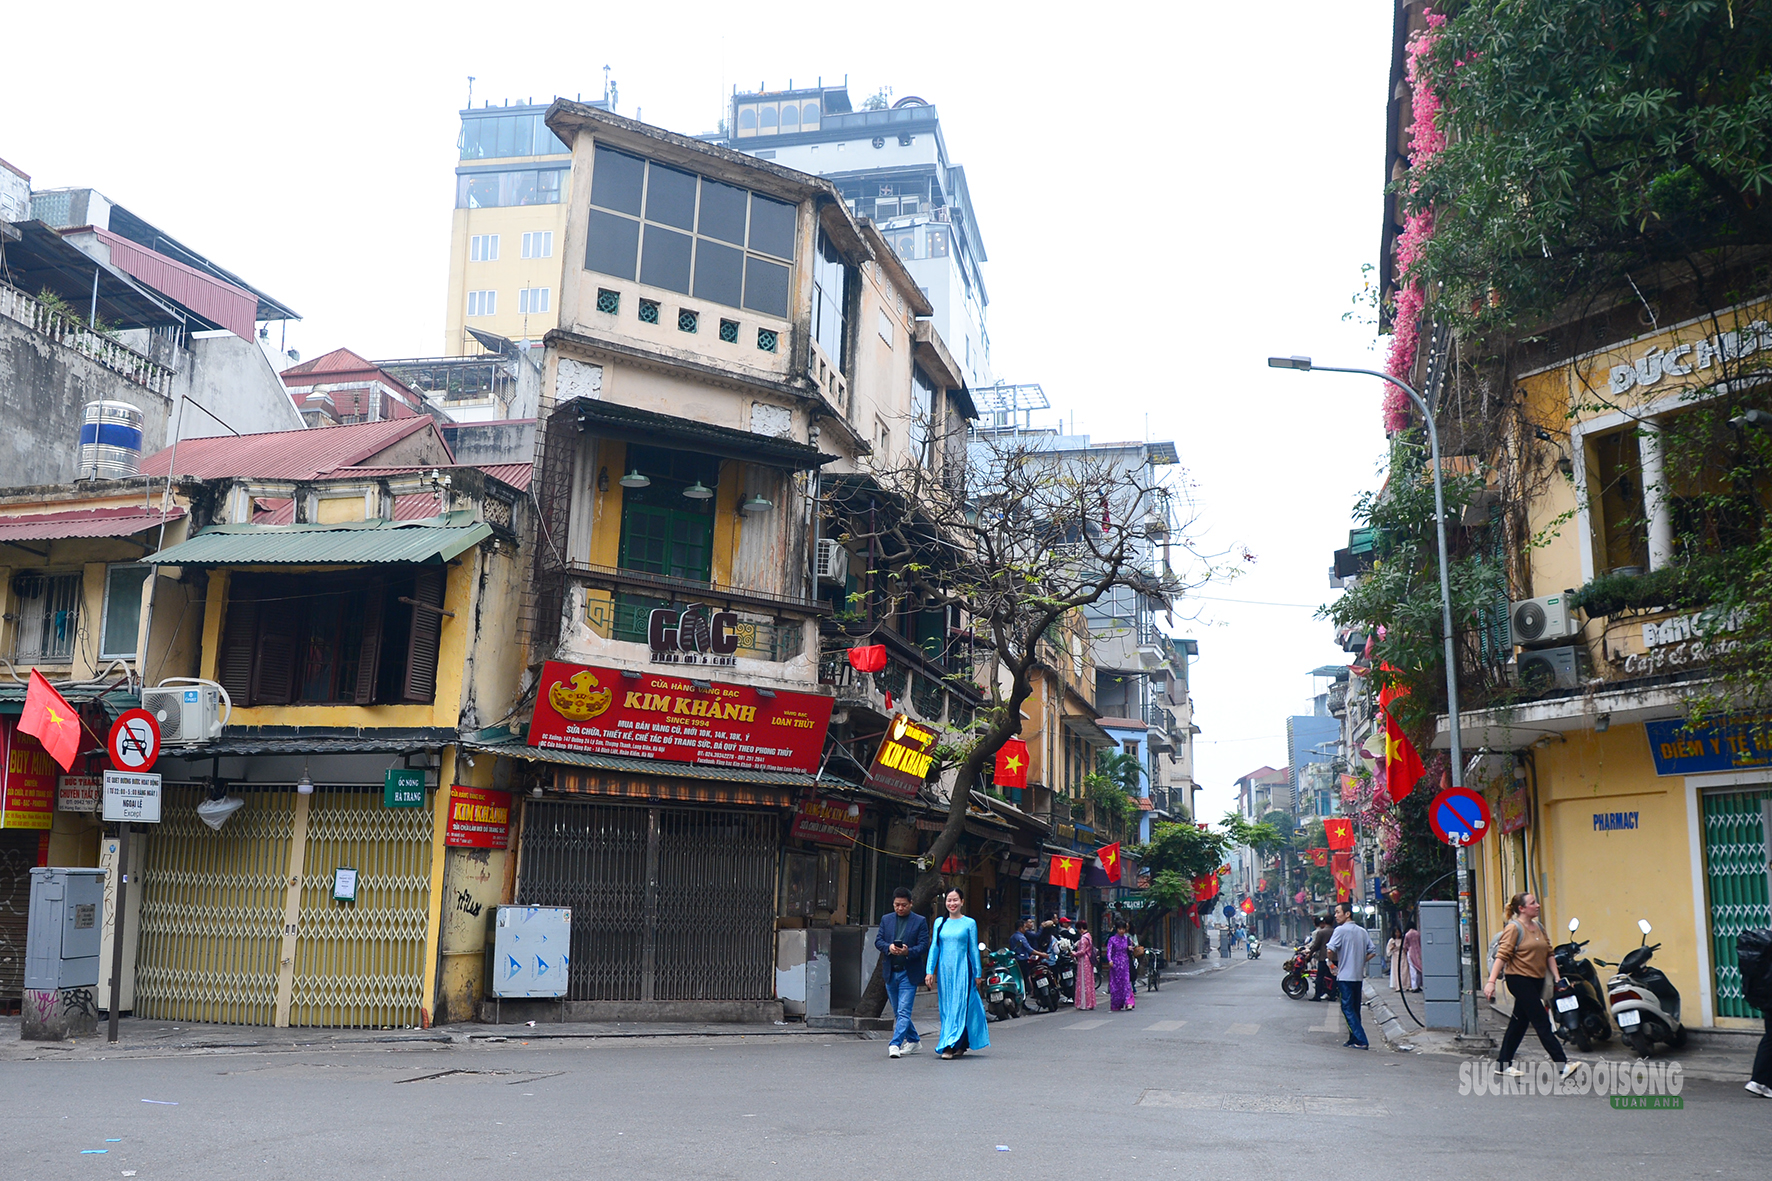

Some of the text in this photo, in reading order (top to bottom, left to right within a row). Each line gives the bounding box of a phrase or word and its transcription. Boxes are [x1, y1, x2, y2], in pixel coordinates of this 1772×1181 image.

[1625, 647, 1666, 675] Café
[651, 679, 668, 690] CỬA
[671, 682, 695, 692] HÀNG
[723, 689, 740, 699] BẠC
[624, 691, 757, 722] KIM KHÁNH
[618, 720, 634, 729] MUA
[635, 721, 650, 731] BÁN
[652, 722, 670, 733] VÀNG
[666, 716, 710, 728] SINCE 1994
[771, 717, 793, 727] LOAN
[674, 737, 696, 747] TRANG
[739, 743, 754, 753] THEO
[755, 745, 776, 756] PHONG
[879, 740, 906, 770] KIM
[1710, 738, 1720, 755] Y
[403, 791, 422, 802] TRANG
[123, 809, 142, 818] Except
[453, 802, 475, 822] KIM
[1593, 811, 1639, 831] PHARMACY
